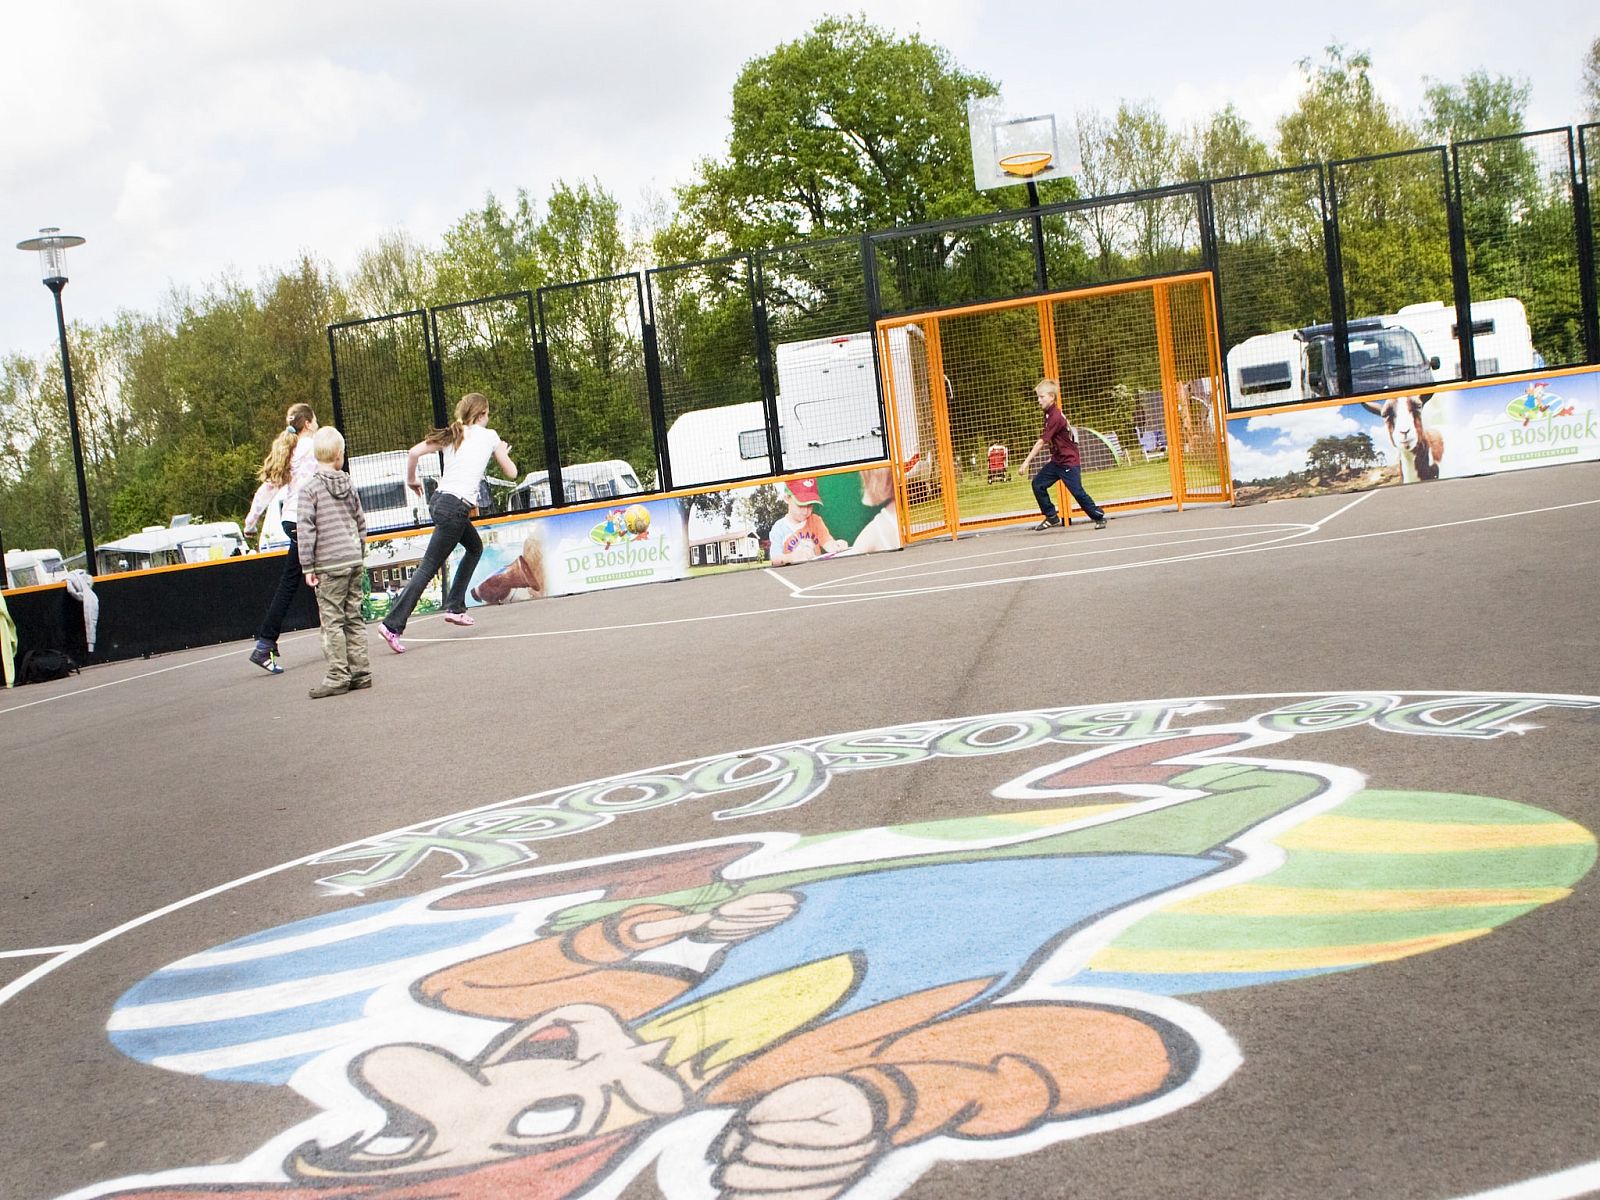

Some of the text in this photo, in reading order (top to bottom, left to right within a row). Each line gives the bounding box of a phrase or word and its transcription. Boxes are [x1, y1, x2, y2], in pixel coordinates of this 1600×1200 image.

[1478, 409, 1598, 452] De Boshoek
[566, 534, 671, 574] De Boshoek
[307, 694, 1594, 898] De Boshoek
